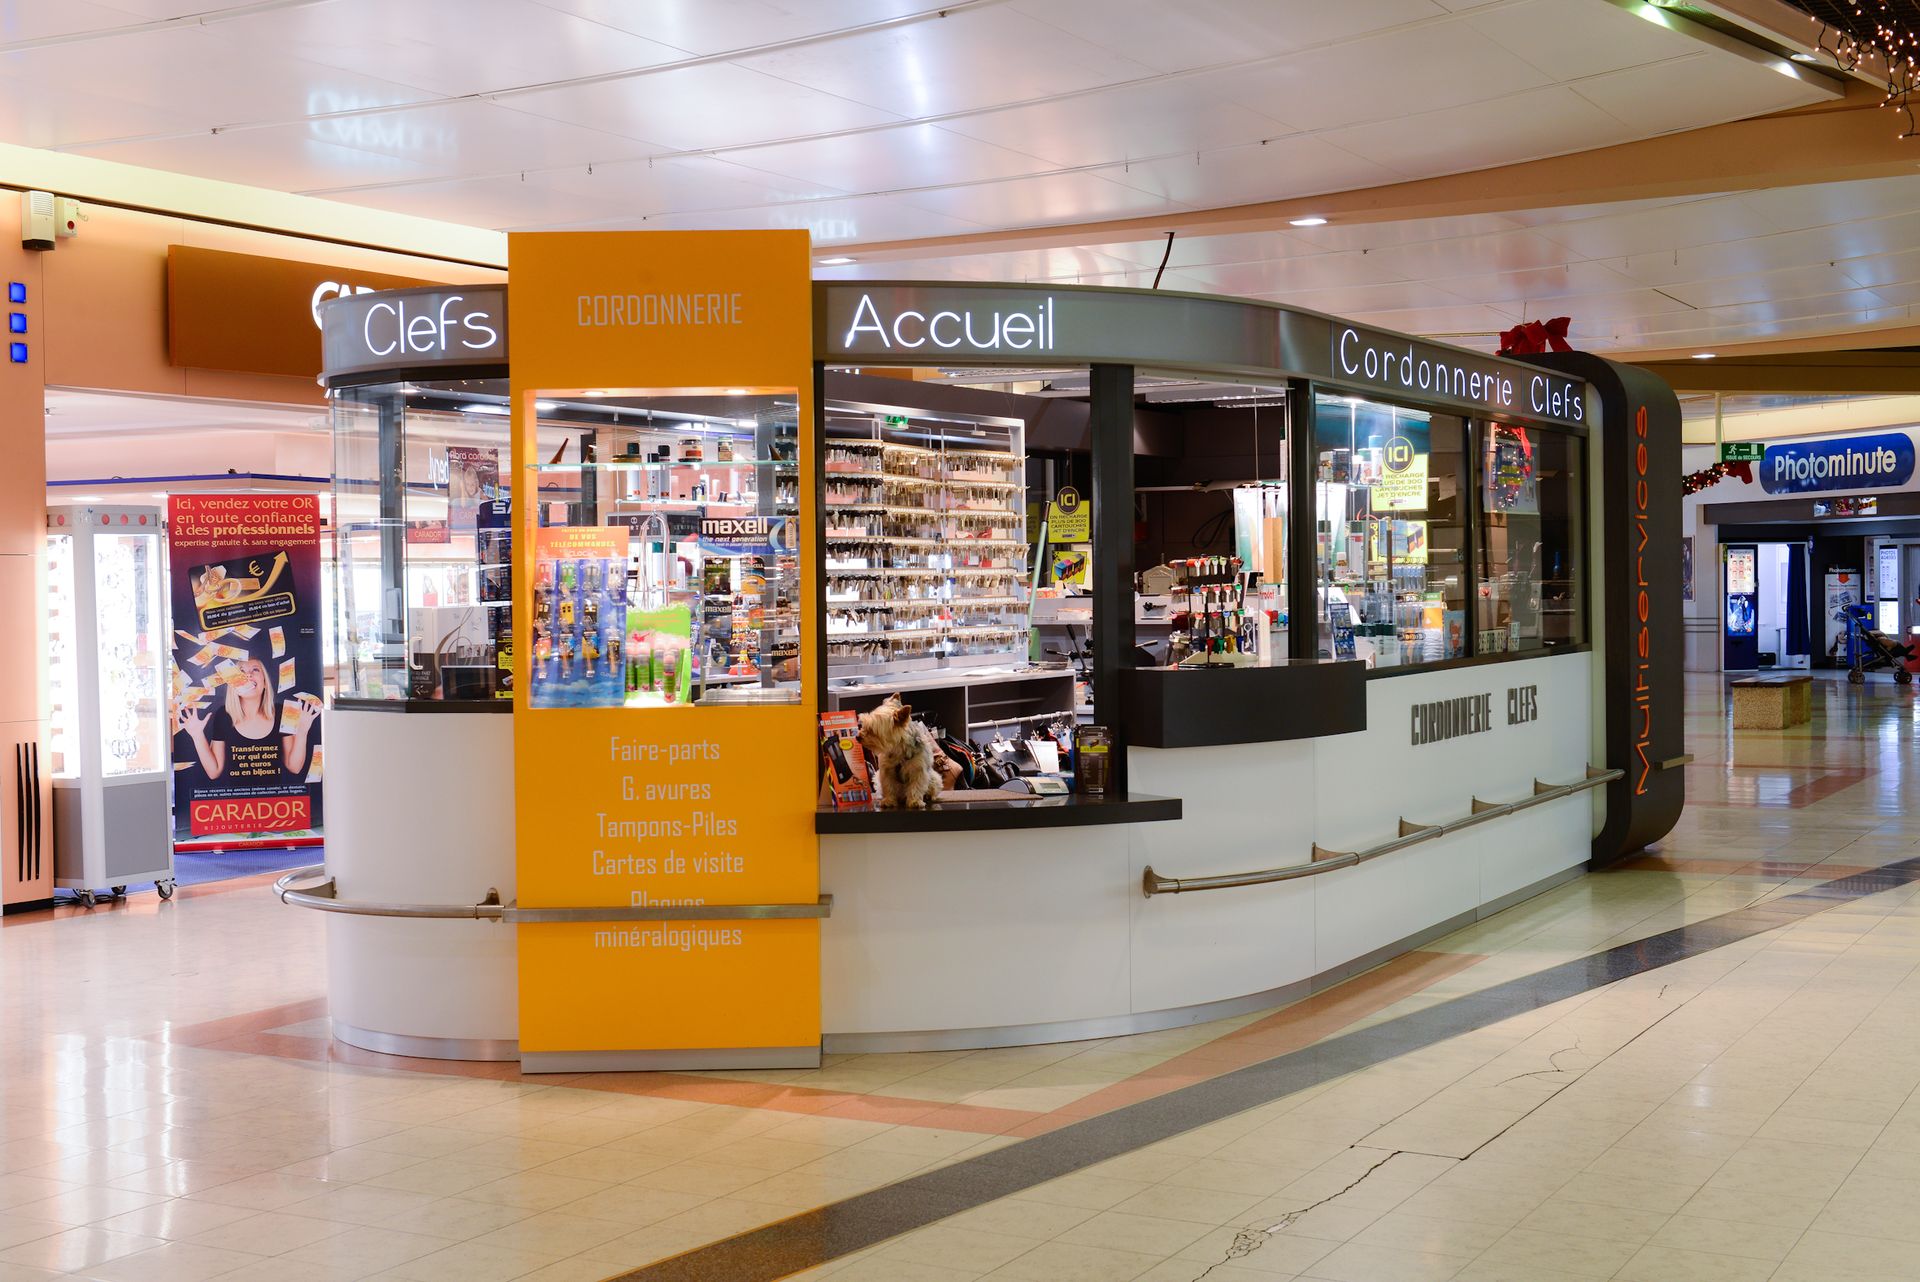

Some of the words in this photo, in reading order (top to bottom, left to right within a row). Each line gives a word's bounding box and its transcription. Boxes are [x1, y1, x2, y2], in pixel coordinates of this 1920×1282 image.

[578, 293, 742, 326] CORDONNERIE
[844, 294, 1053, 350] Accueil
[364, 296, 497, 357] Clefs
[1339, 328, 1513, 406] Cordonnerie
[1530, 377, 1583, 422] Clefs
[1388, 446, 1408, 462] ICI
[1775, 446, 1897, 481] Photominute
[176, 499, 195, 510] Ici,
[200, 499, 249, 509] vendez
[254, 499, 288, 509] votre
[293, 498, 313, 509] OR
[1061, 494, 1075, 506] ICI
[176, 526, 182, 535] à
[187, 525, 209, 535] des
[213, 524, 315, 537] professionnels
[177, 515, 193, 523] en
[200, 513, 238, 523] toute
[245, 512, 313, 522] confiance
[702, 518, 767, 534] maxell
[270, 539, 316, 547] engagement
[1635, 404, 1650, 795] Multiservices
[1411, 692, 1492, 745] CORDONNERIE
[1507, 684, 1538, 726] CLEFS
[248, 753, 260, 761] qui
[611, 736, 721, 765] Faire-parts
[252, 768, 276, 776] bijoux
[194, 801, 306, 823] CARADOR
[597, 812, 737, 841] Tampons-Piles
[593, 850, 657, 875] Cartes
[664, 849, 685, 875] de
[693, 851, 744, 874] visite
[595, 921, 742, 951] minéralogiques
